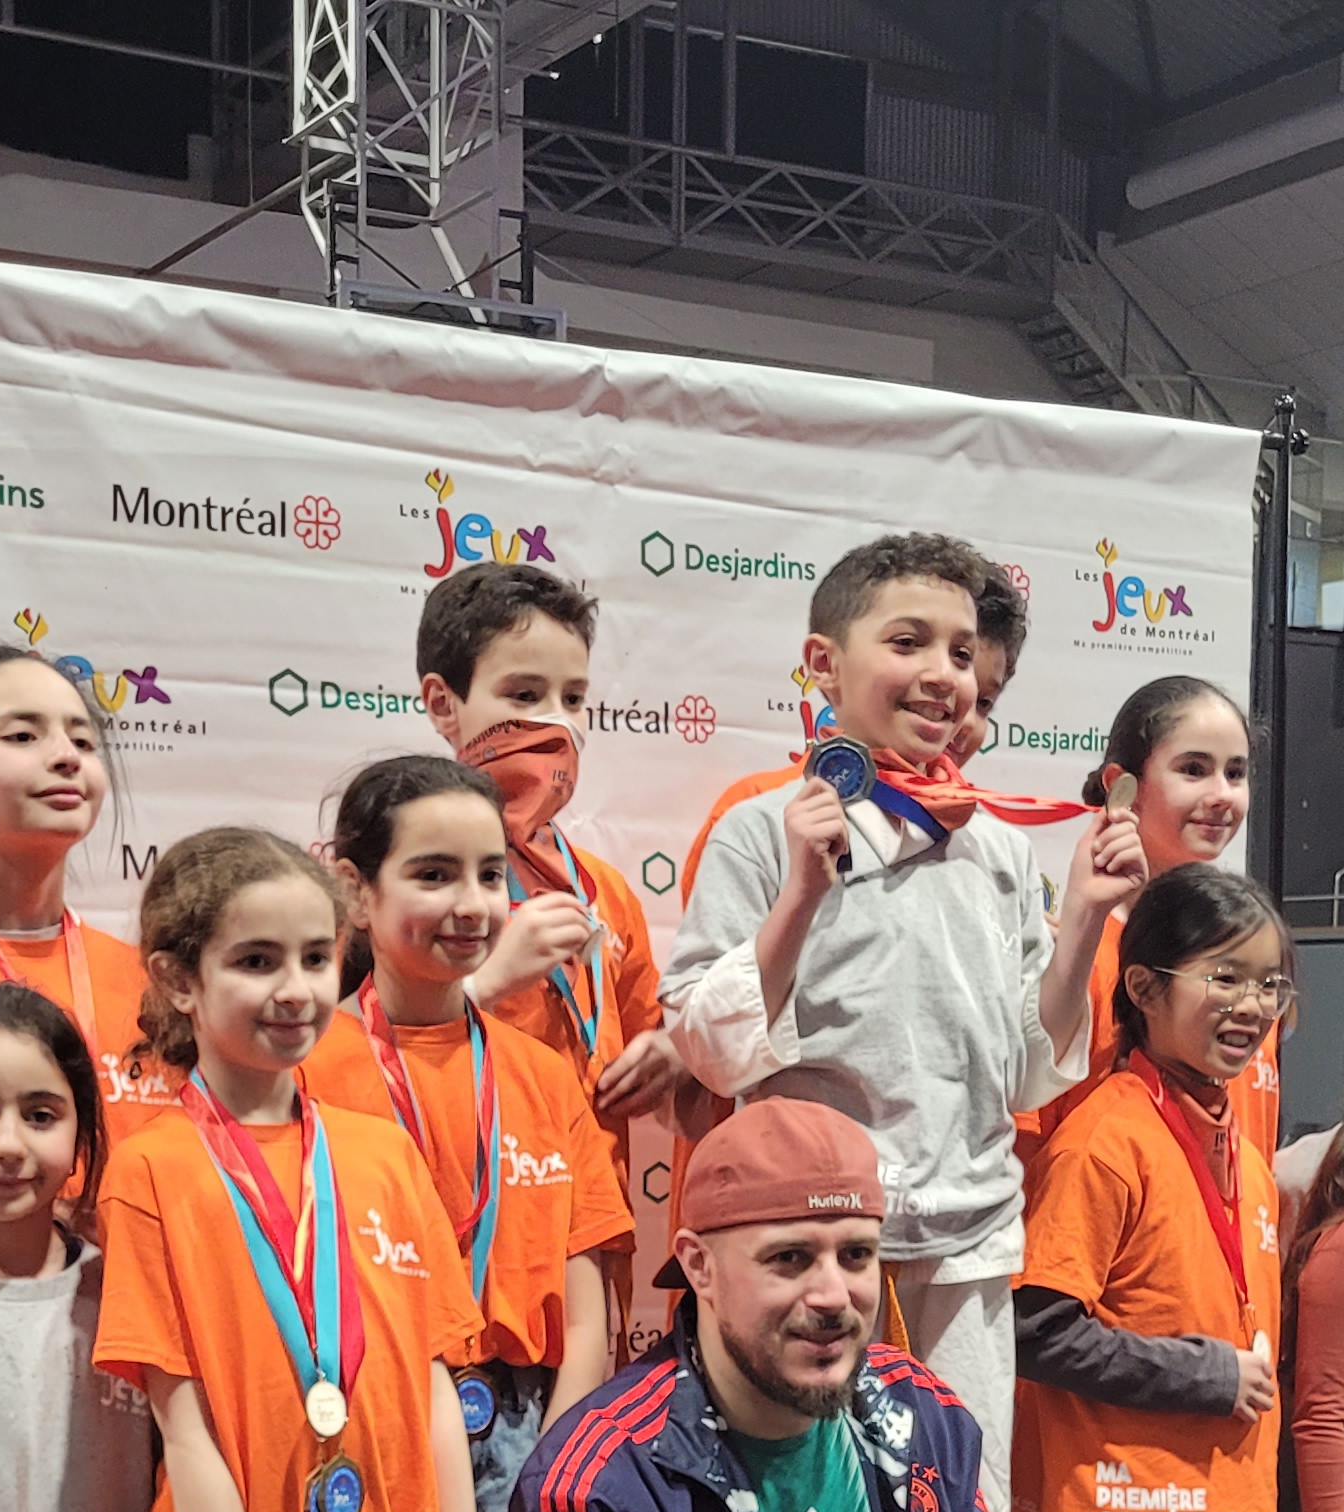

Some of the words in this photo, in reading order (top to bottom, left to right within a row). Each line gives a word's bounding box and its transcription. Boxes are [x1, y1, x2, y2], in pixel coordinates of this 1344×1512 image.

[112, 483, 286, 538] Montréal
[399, 504, 430, 519] Les
[424, 507, 556, 578] jeux
[685, 543, 816, 581] Desjardins
[1075, 569, 1099, 582] Les
[1092, 571, 1193, 633] jeux
[1120, 624, 1137, 636] de
[1145, 626, 1216, 642] Montréal
[1090, 641, 1133, 652] première
[1137, 646, 1193, 656] compétition
[767, 699, 794, 712] Les
[1008, 723, 1110, 755] Desjardin
[505, 1149, 567, 1186] jeux
[808, 1193, 851, 1209] Hurley
[1096, 1461, 1132, 1483] MA
[1096, 1482, 1206, 1510] PREMIÈRE
